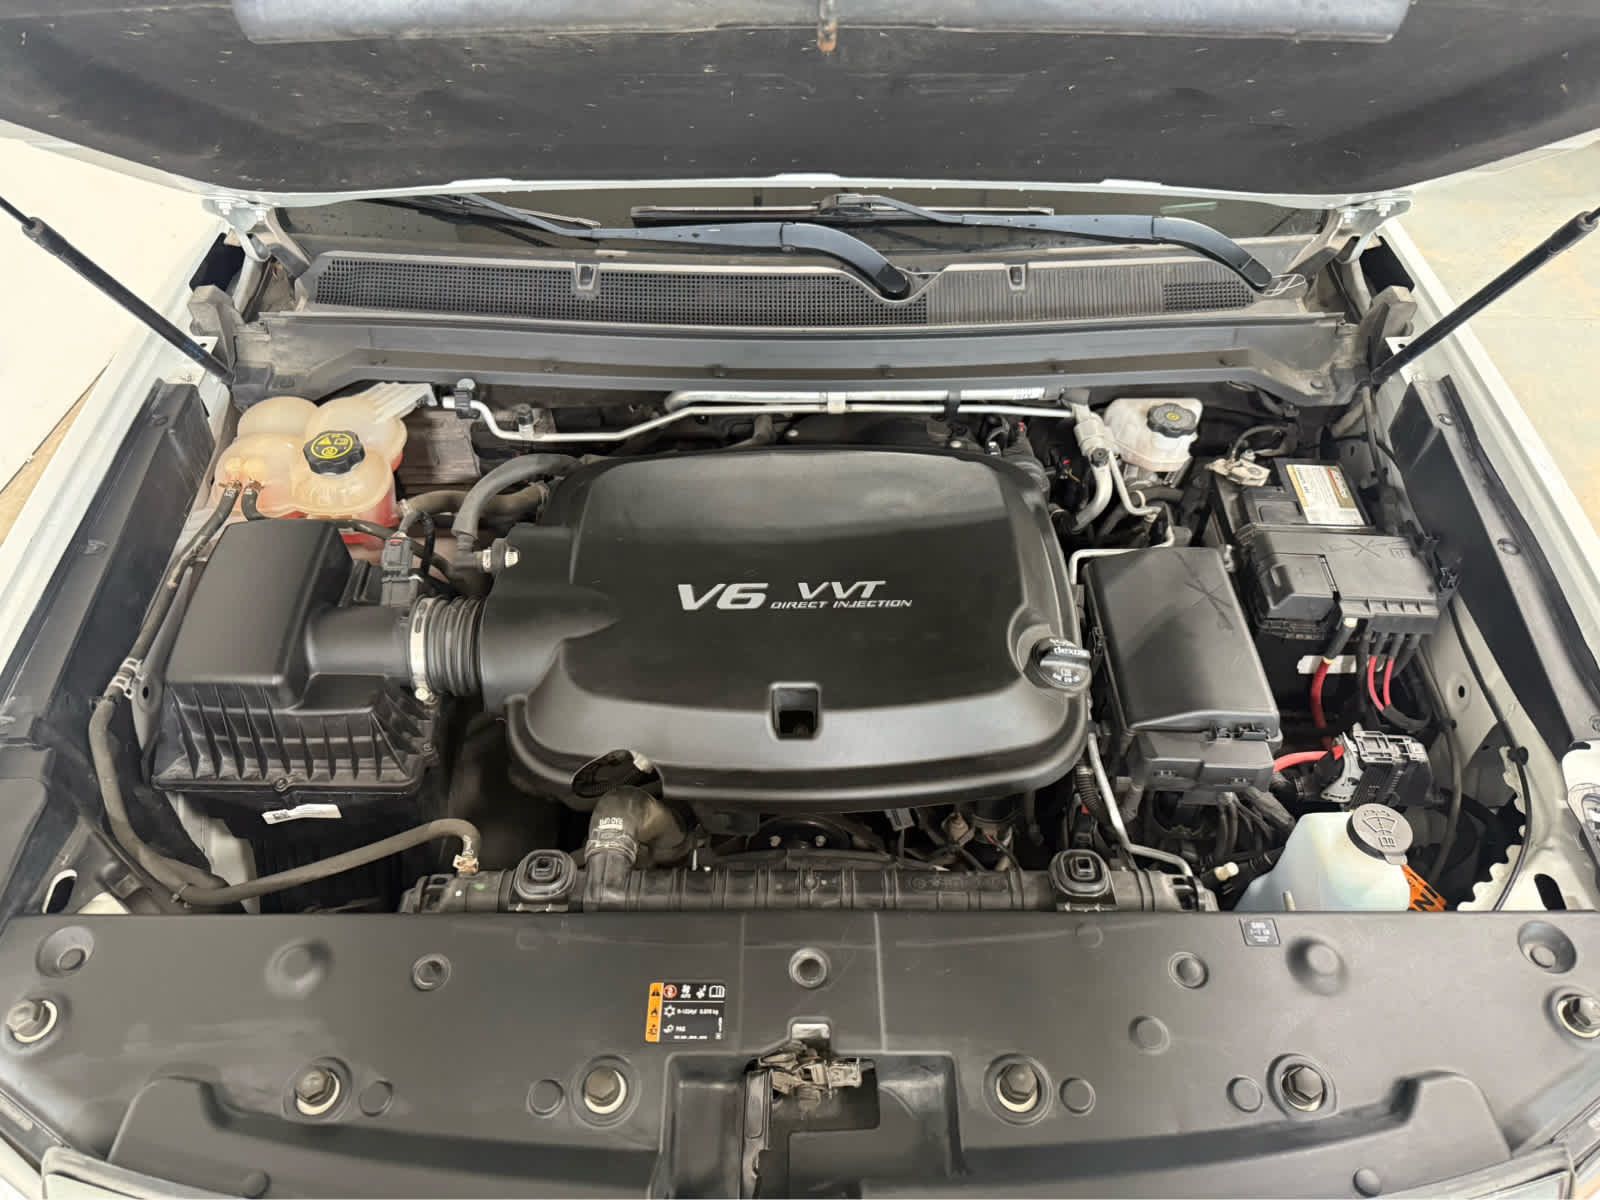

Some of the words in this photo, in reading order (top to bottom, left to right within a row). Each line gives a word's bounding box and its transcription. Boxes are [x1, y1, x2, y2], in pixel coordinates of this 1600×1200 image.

[677, 582, 769, 611] V6
[797, 580, 887, 600] VVT
[770, 600, 828, 609] DIRECT
[832, 598, 913, 609] INJECTION
